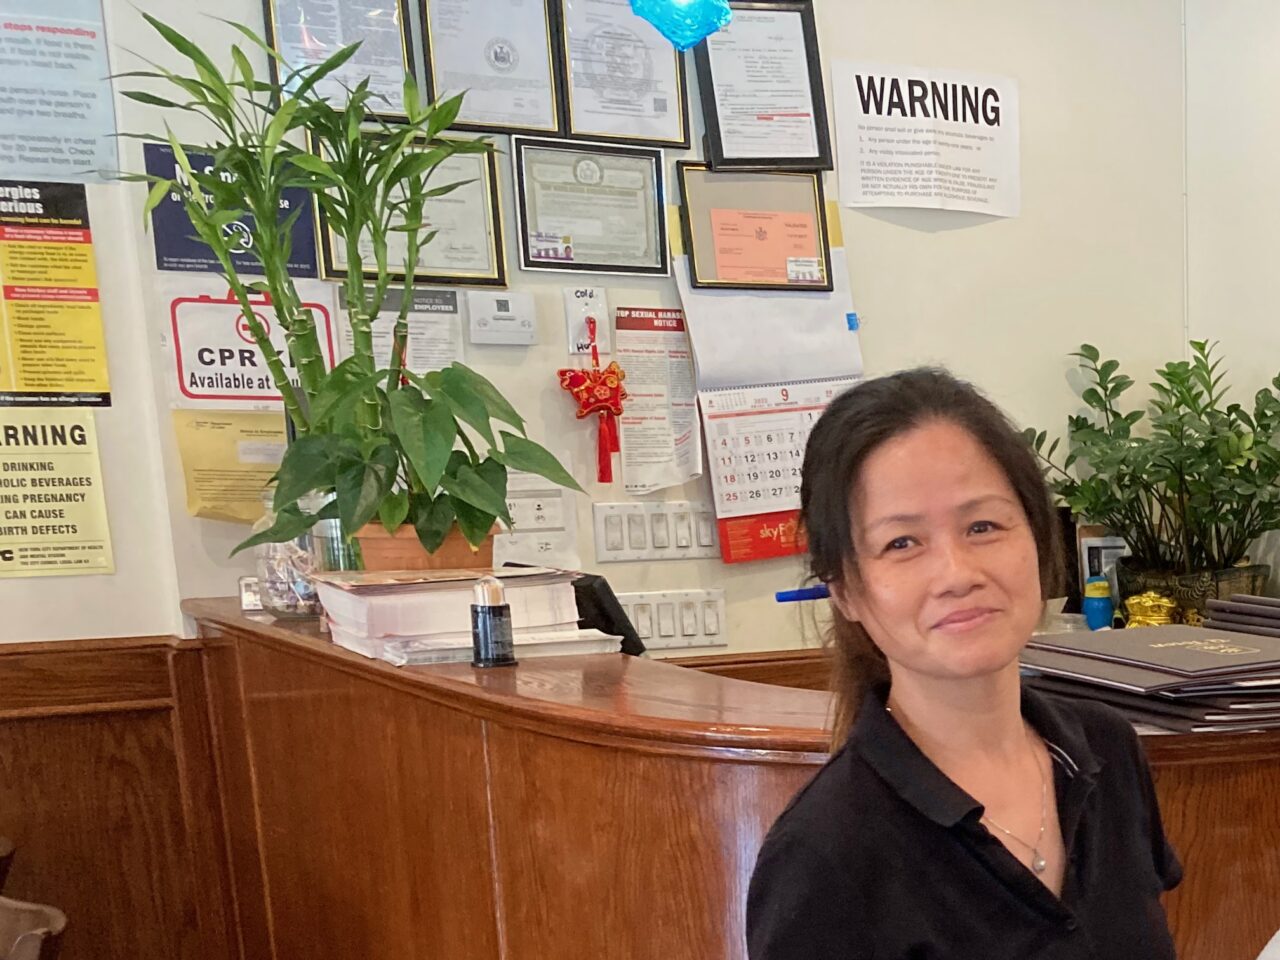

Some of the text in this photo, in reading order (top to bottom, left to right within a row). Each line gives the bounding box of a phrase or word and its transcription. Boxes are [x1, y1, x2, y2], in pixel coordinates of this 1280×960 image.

[35, 25, 96, 39] responding
[855, 74, 1000, 127] WARNING
[575, 289, 594, 298] Cold
[414, 304, 454, 312] EMPLOYEES
[631, 310, 656, 318] SEXUAL
[654, 319, 678, 327] NOTICE
[198, 348, 258, 368] CPR
[190, 372, 254, 389] Available
[258, 376, 271, 390] at
[781, 388, 789, 401] 9
[0, 424, 87, 446] RNING
[744, 436, 750, 444] 5
[766, 434, 772, 442] 6
[788, 432, 794, 440] 7
[722, 450, 800, 465] 11 12 13 14
[2, 462, 54, 472] DRINKING
[0, 476, 92, 488] OLIC BEVERAGES
[724, 474, 736, 482] 18
[748, 472, 758, 480] 19
[769, 470, 780, 478] 20
[22, 492, 86, 503] PREGNANCY
[725, 493, 738, 502] 25
[749, 490, 761, 498] 26
[772, 488, 783, 496] 27
[4, 508, 65, 520] CAN CAUSE
[32, 524, 78, 535] DEFECTS
